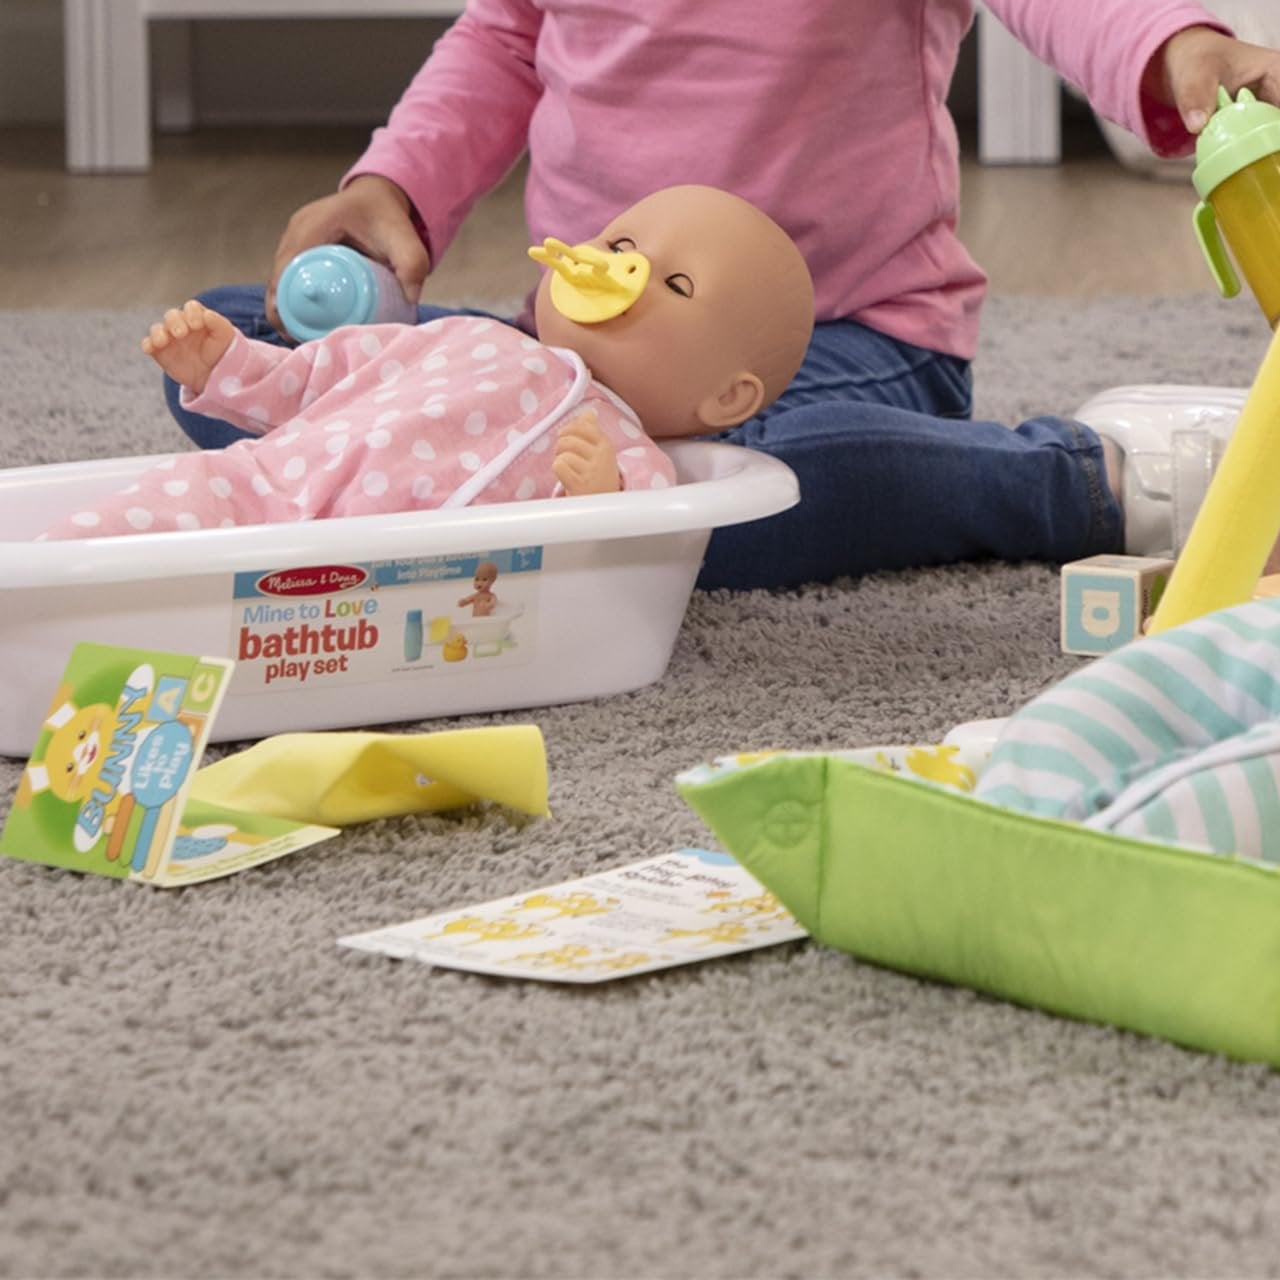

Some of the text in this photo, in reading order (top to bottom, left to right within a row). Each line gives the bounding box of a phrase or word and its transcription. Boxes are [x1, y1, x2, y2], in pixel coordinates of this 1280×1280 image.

[266, 575, 317, 592] Melissa
[329, 571, 360, 589] Doug
[243, 597, 379, 625] Mine to Love
[238, 618, 379, 660] bathtub
[265, 655, 348, 683] play set
[157, 686, 181, 717] A
[191, 671, 215, 703] C
[77, 685, 147, 838] BUNNY
